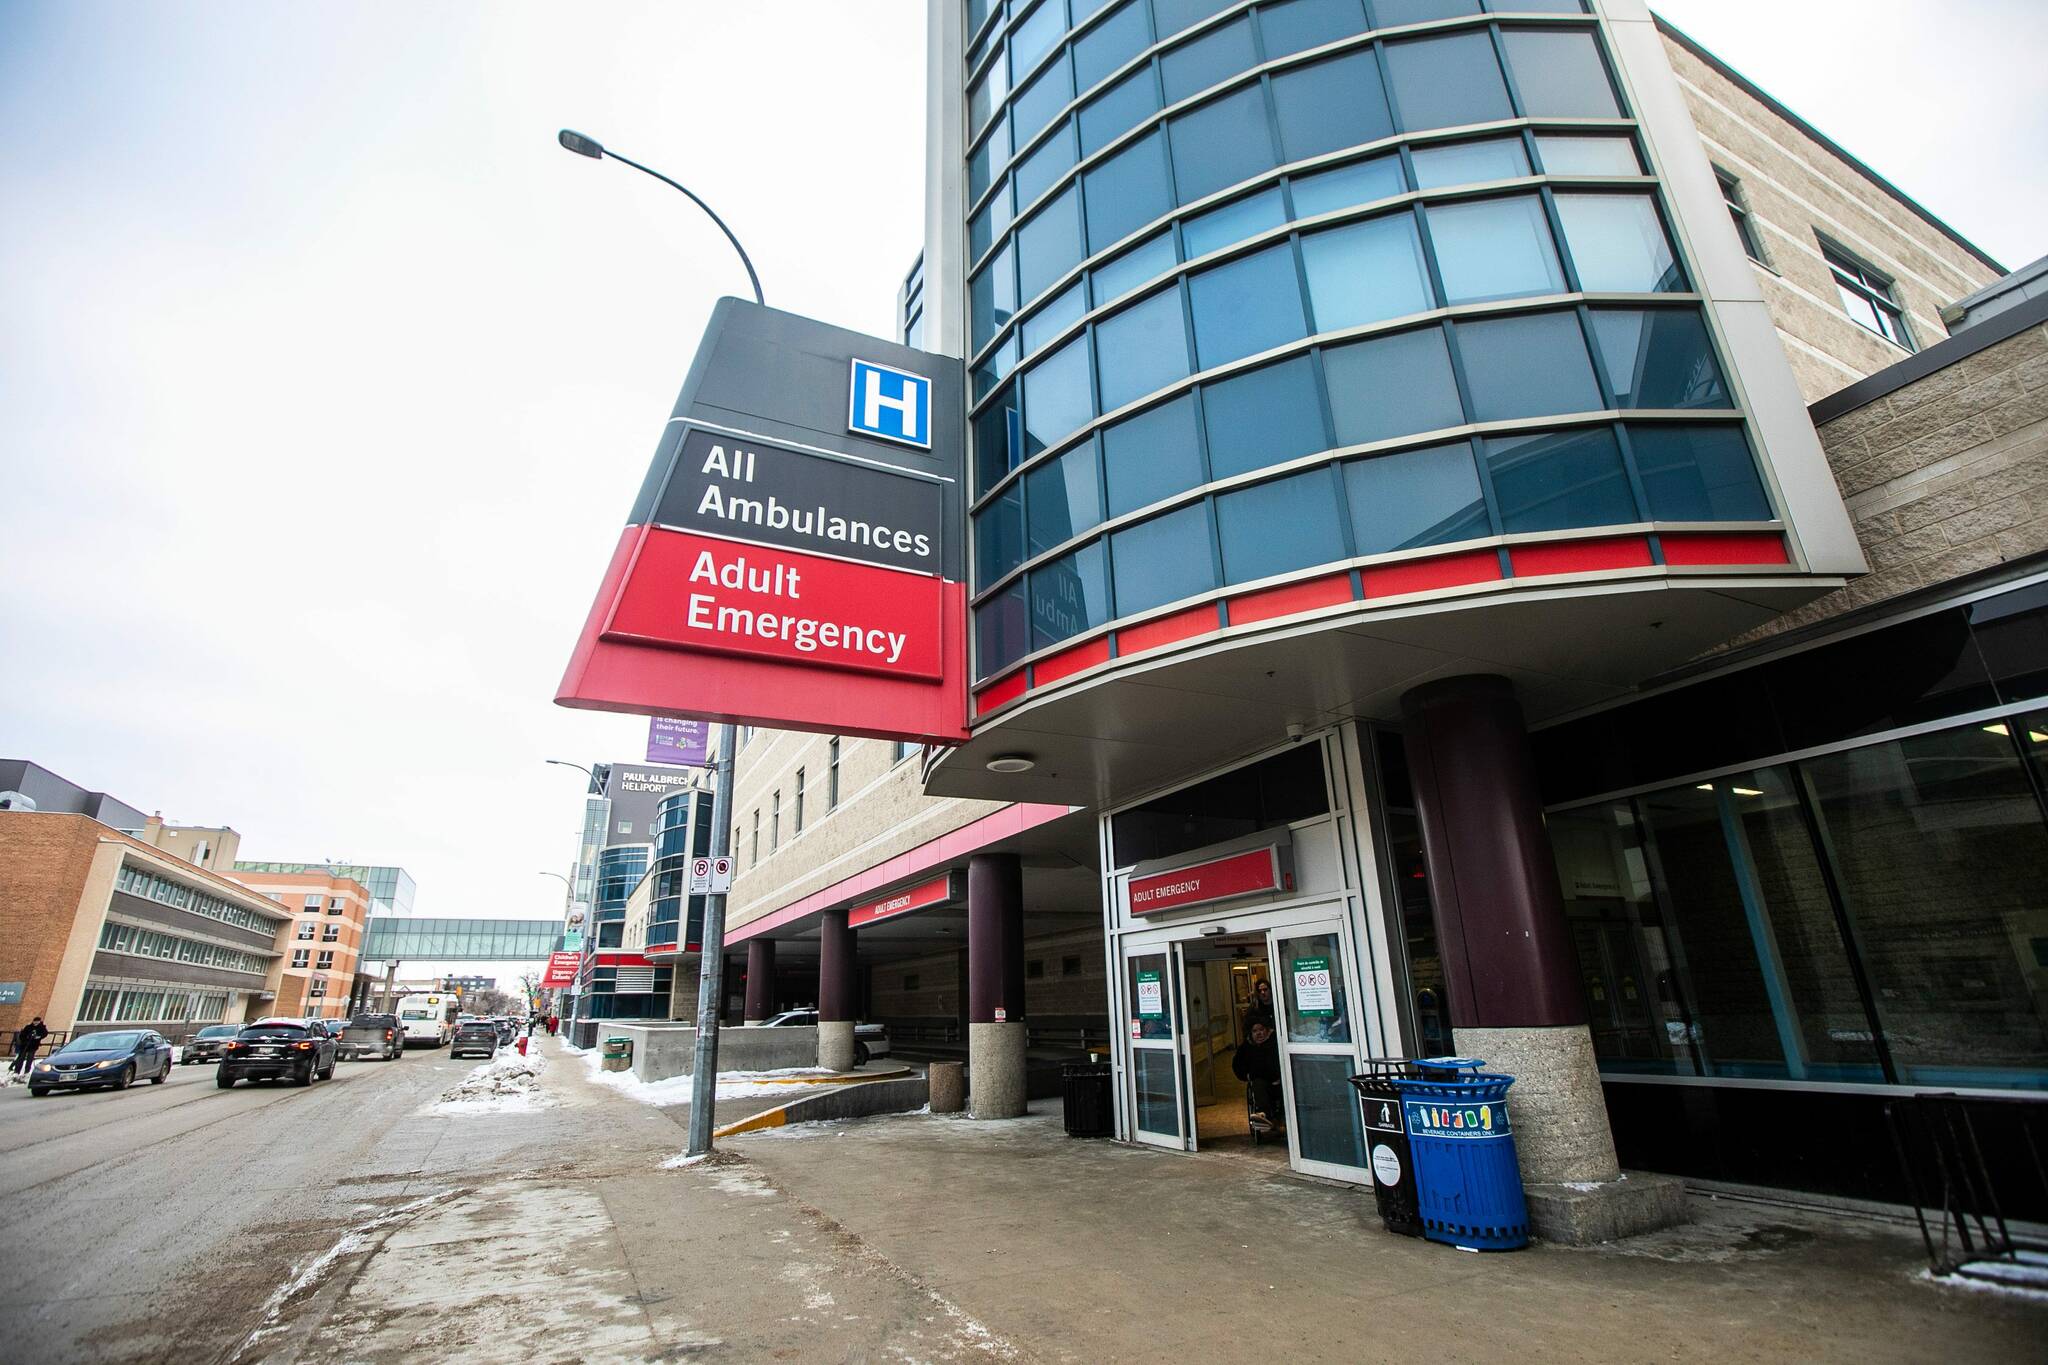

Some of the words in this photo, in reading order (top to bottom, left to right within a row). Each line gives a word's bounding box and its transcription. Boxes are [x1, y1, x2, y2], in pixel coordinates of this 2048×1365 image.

[863, 369, 918, 439] H
[701, 445, 756, 483] All
[697, 484, 931, 557] Ambulances
[688, 550, 801, 600] Adult
[686, 593, 907, 663] Emergency
[656, 723, 674, 731] their
[664, 717, 698, 728] changing
[621, 781, 667, 793] HELIPORT
[622, 772, 648, 783] PAUL
[1133, 889, 1154, 903] ADULT
[1155, 879, 1200, 899] EMERGENCY
[874, 903, 886, 914] ADULT
[886, 895, 911, 911] EMERGENCY
